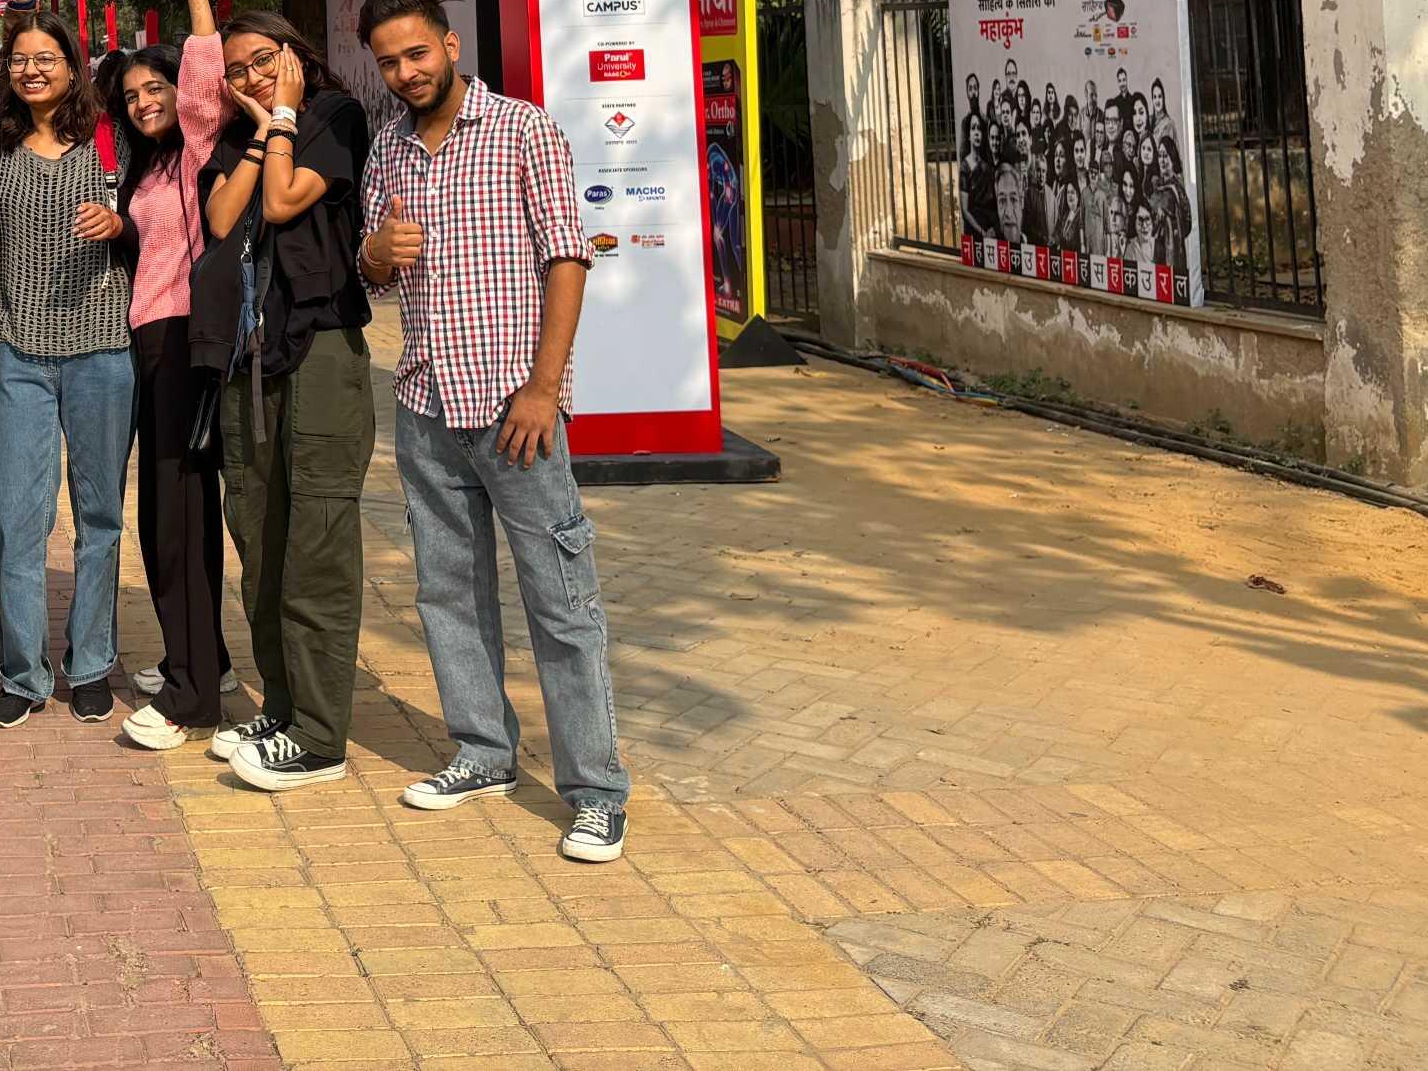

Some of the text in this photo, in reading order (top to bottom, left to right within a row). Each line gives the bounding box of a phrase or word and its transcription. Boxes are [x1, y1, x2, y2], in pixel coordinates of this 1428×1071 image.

[587, 0, 638, 13] CAMPUS
[978, 11, 1024, 49] महाकुंभ
[604, 53, 630, 62] Parul
[597, 62, 636, 71] University
[710, 99, 736, 120] Ortho
[626, 186, 665, 195] MACHO
